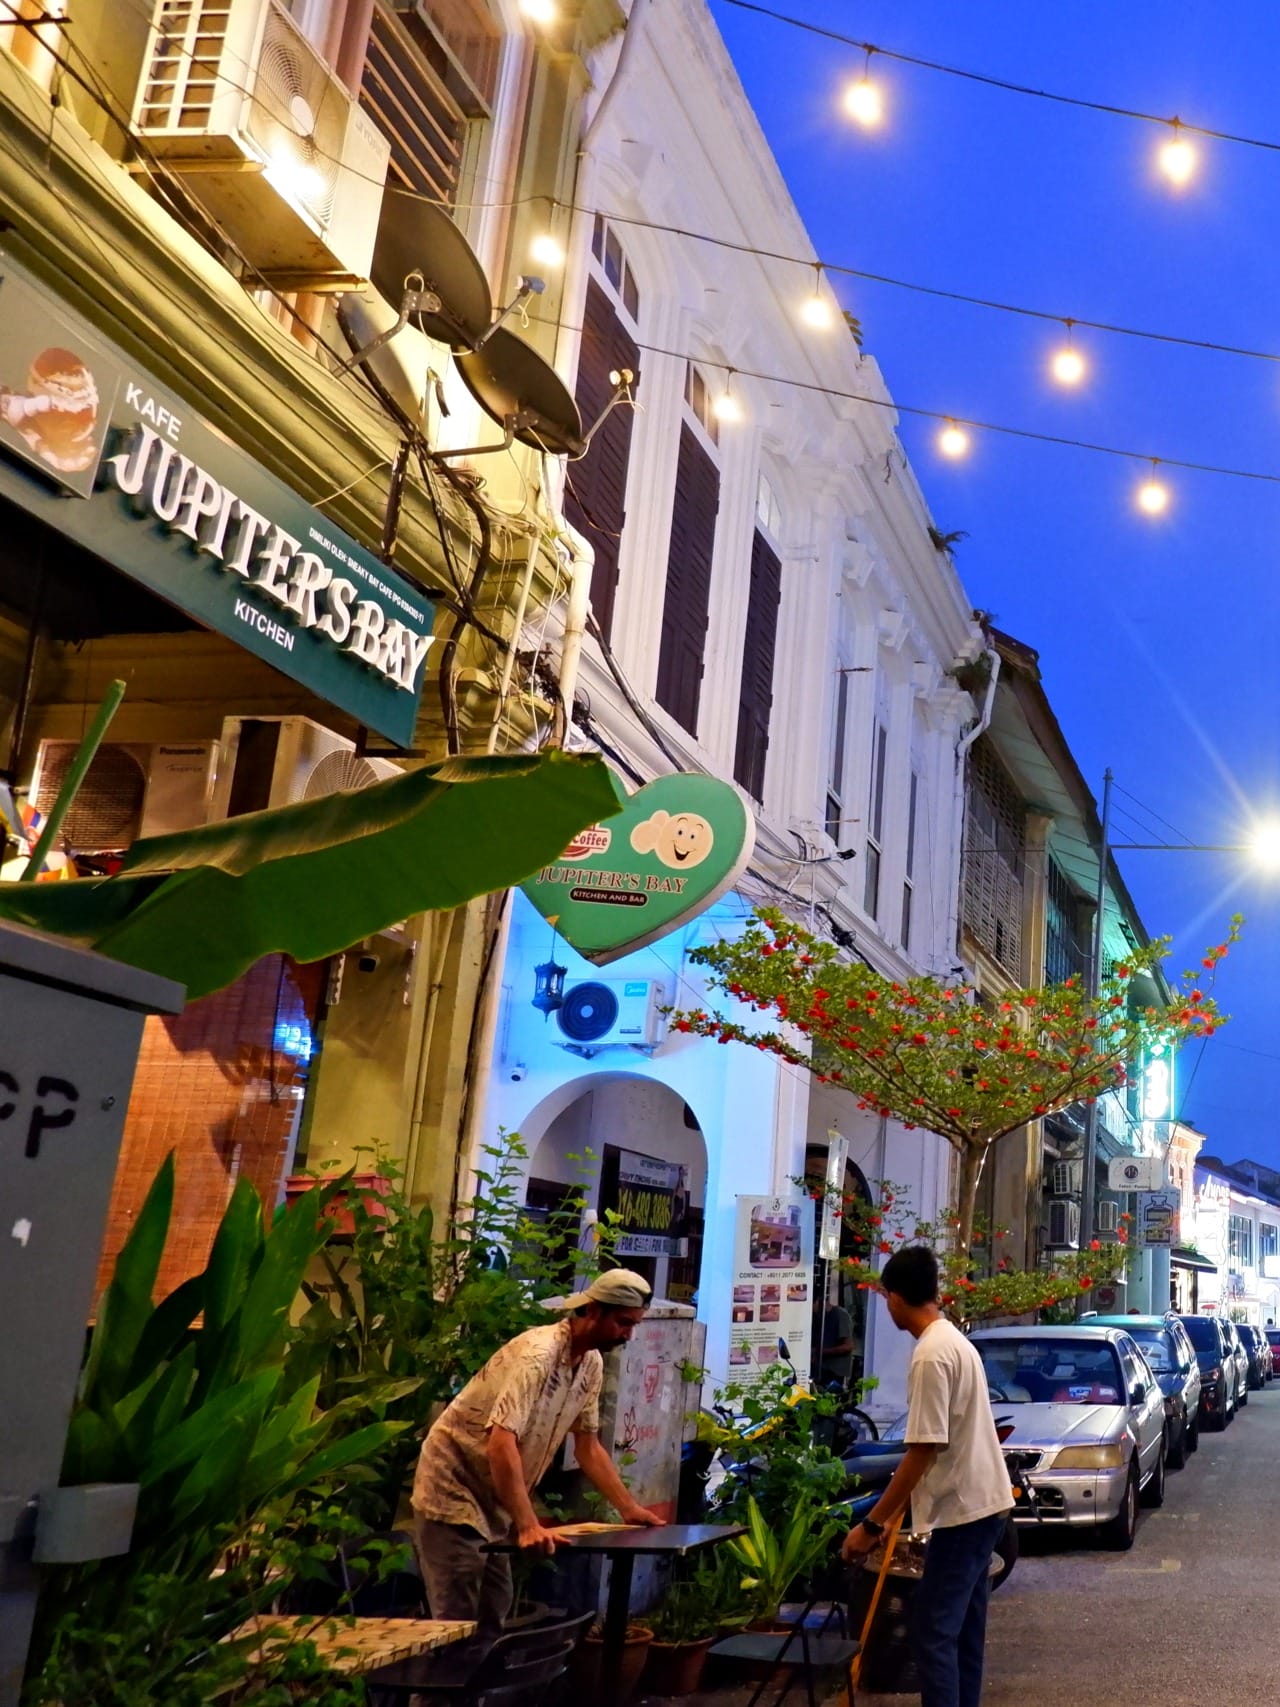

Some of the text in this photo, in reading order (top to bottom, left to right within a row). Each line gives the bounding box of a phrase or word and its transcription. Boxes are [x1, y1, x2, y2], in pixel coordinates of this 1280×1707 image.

[126, 382, 182, 442] KAFE
[378, 582, 393, 599] CAFE
[233, 598, 296, 652] KITCHEN
[339, 600, 436, 695] BAY
[536, 866, 688, 894] JUPITER'S BAY
[573, 889, 645, 903] KITCHEN AND BAR
